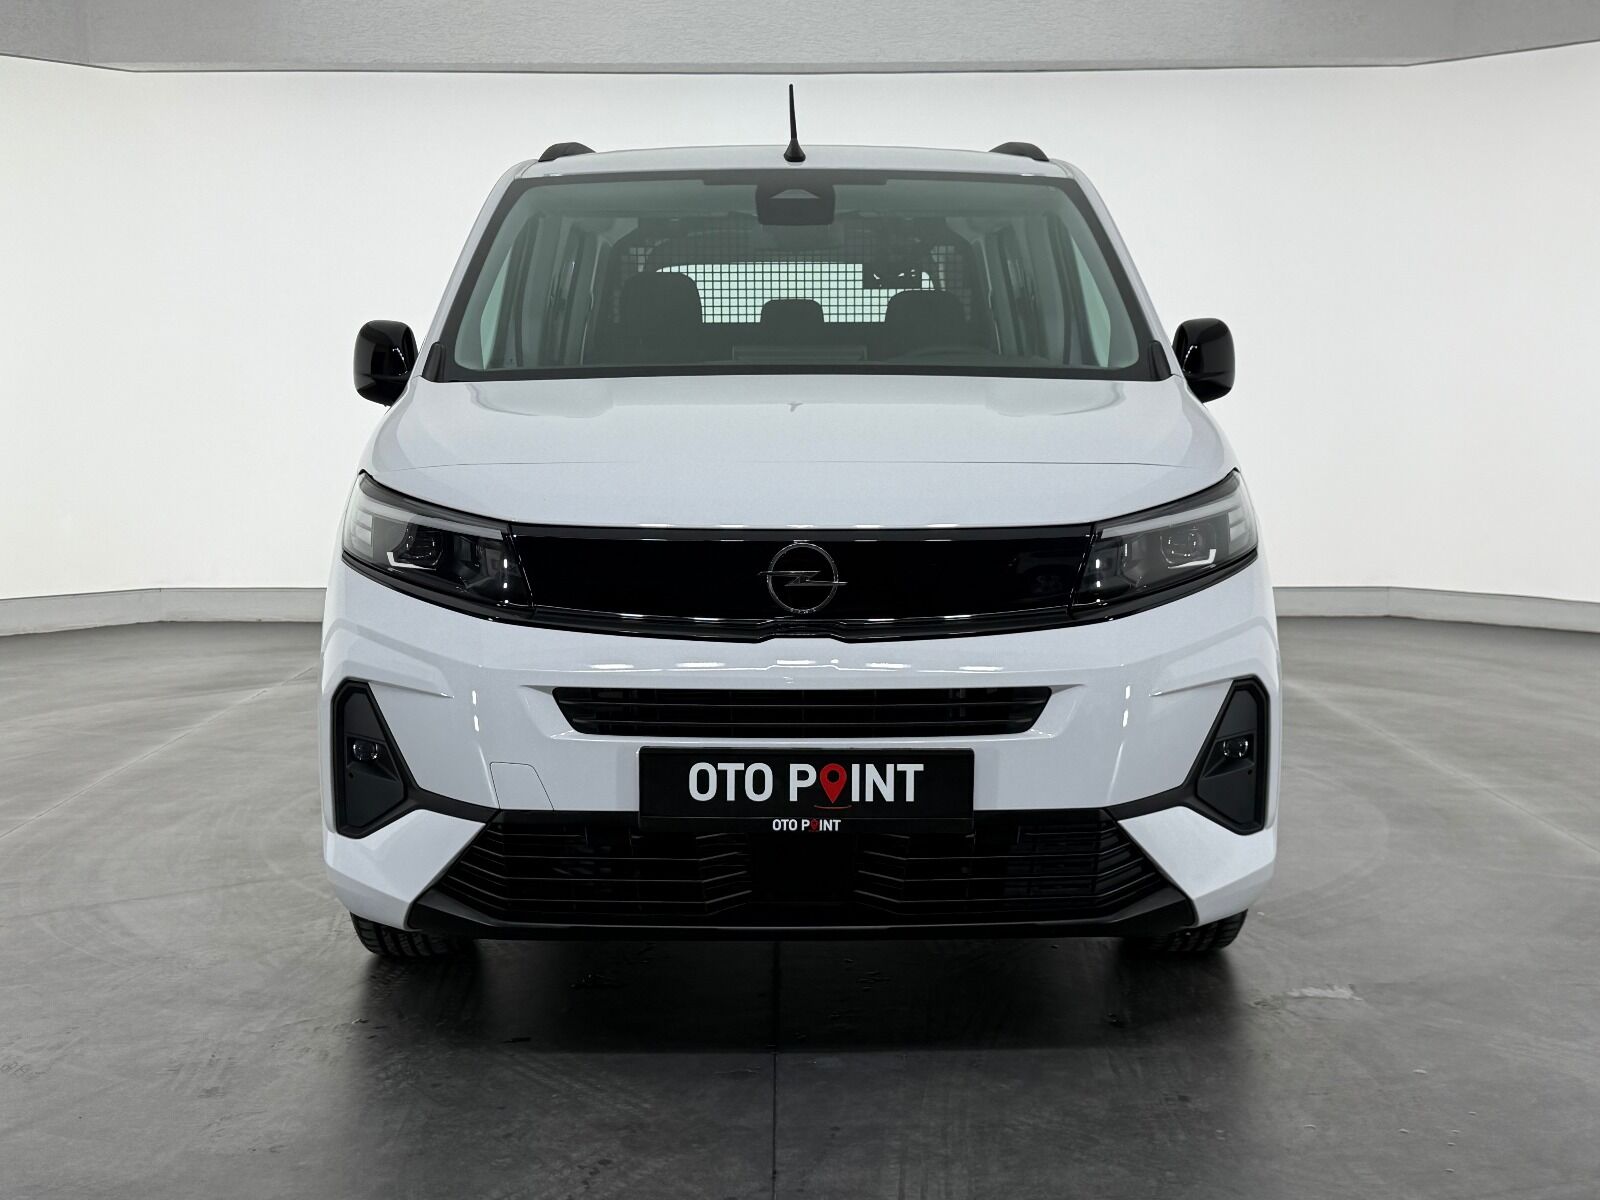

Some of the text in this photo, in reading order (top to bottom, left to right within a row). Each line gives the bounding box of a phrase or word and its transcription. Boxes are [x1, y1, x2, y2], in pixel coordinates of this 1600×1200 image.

[688, 762, 924, 804] OTO POINT
[772, 819, 797, 831] OTO
